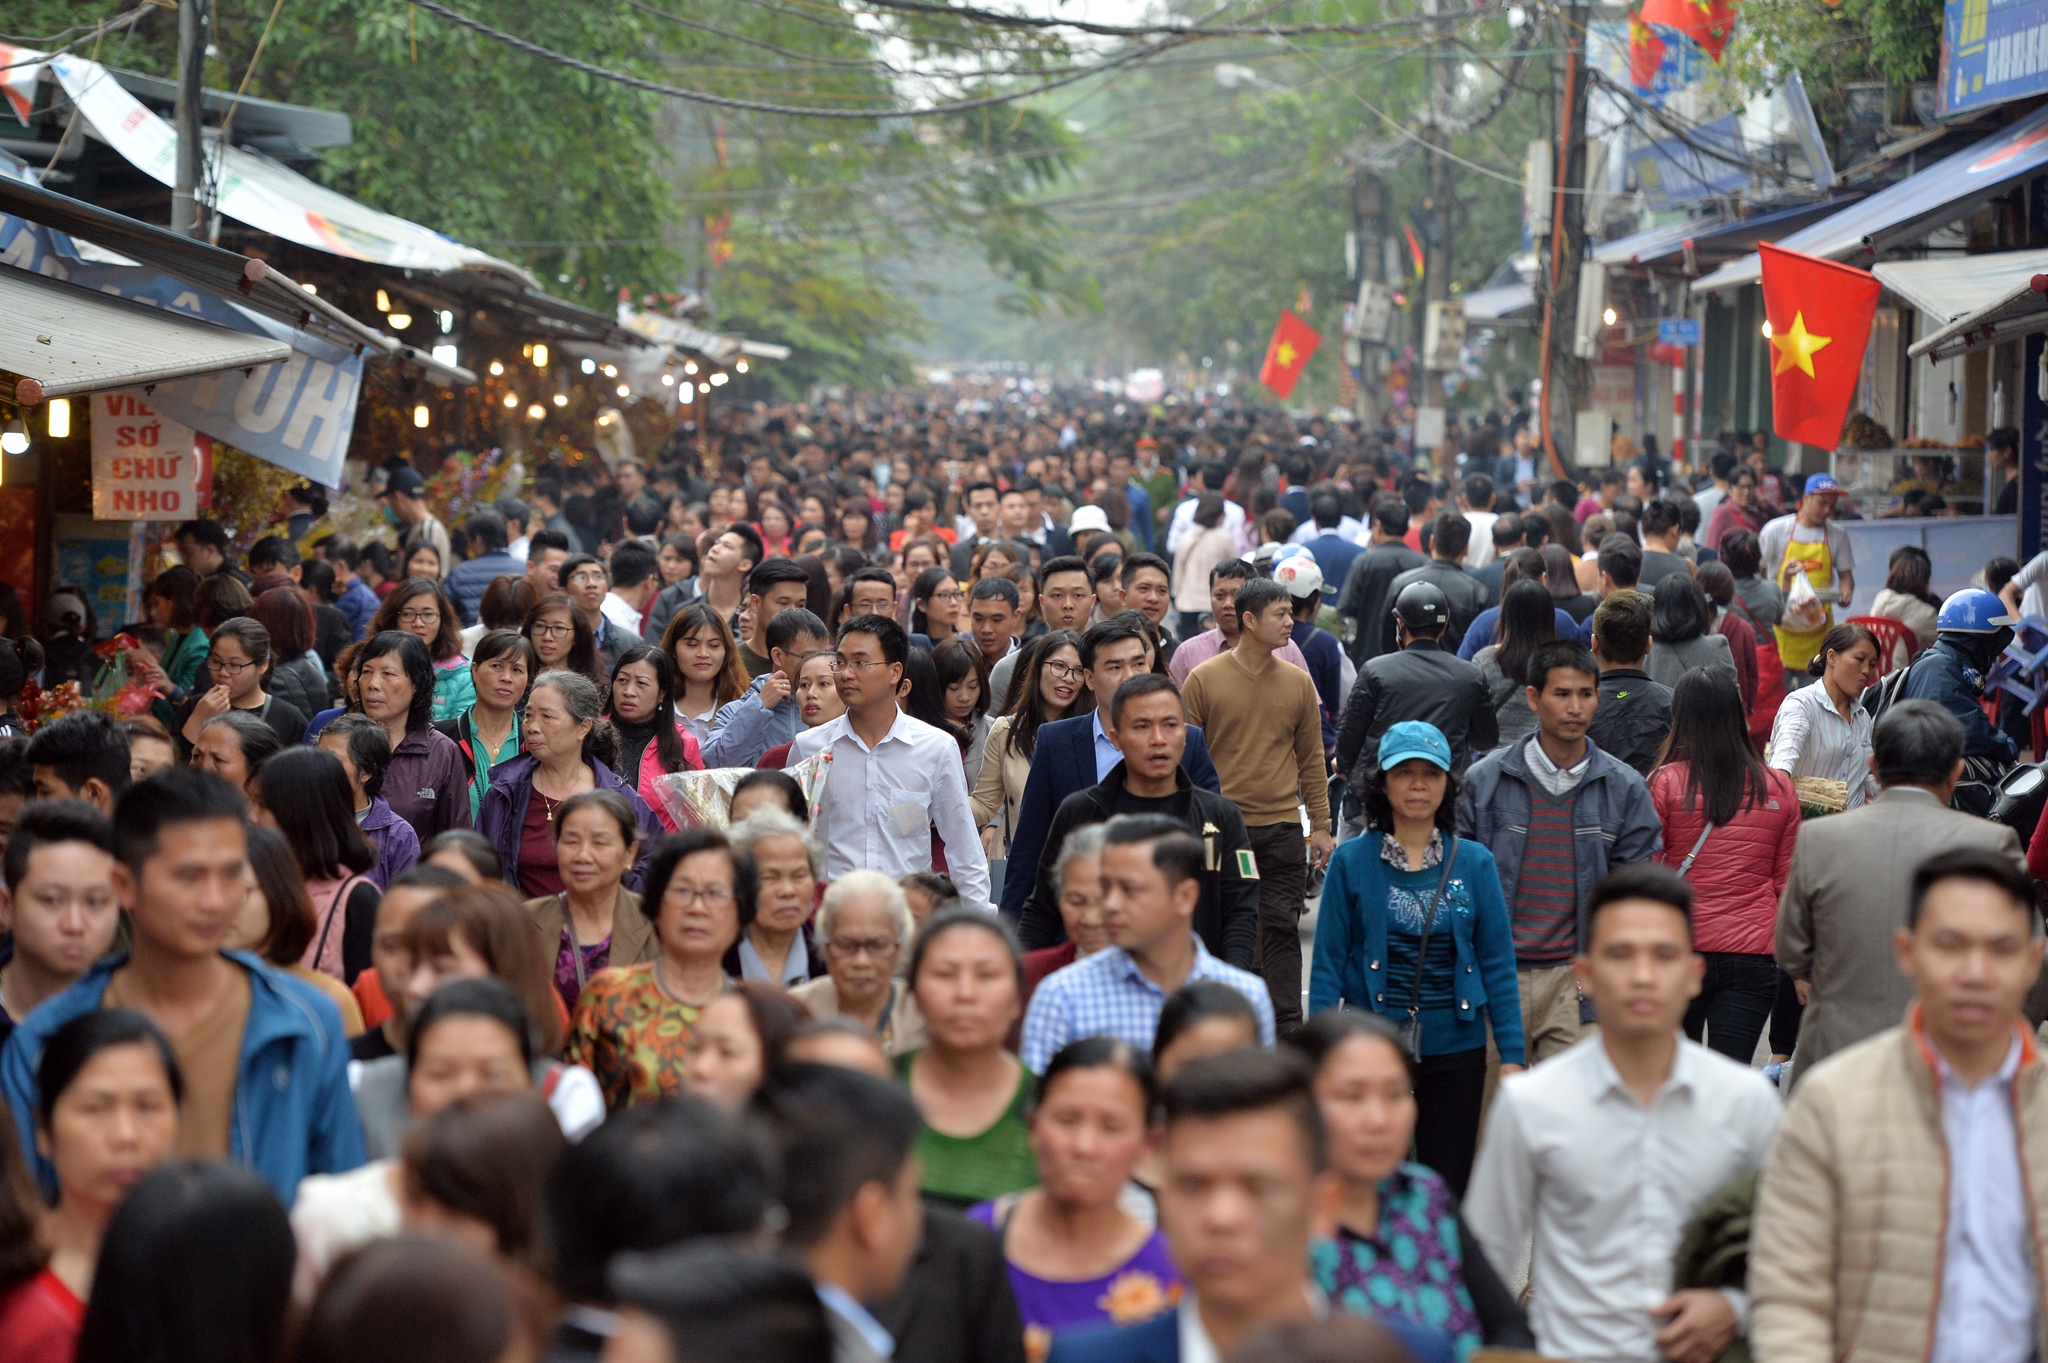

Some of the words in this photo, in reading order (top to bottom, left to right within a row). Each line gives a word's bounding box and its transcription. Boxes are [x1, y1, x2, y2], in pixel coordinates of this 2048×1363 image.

[116, 420, 161, 447] SỚ
[112, 451, 182, 479] CHỮ
[113, 490, 180, 512] NHO
